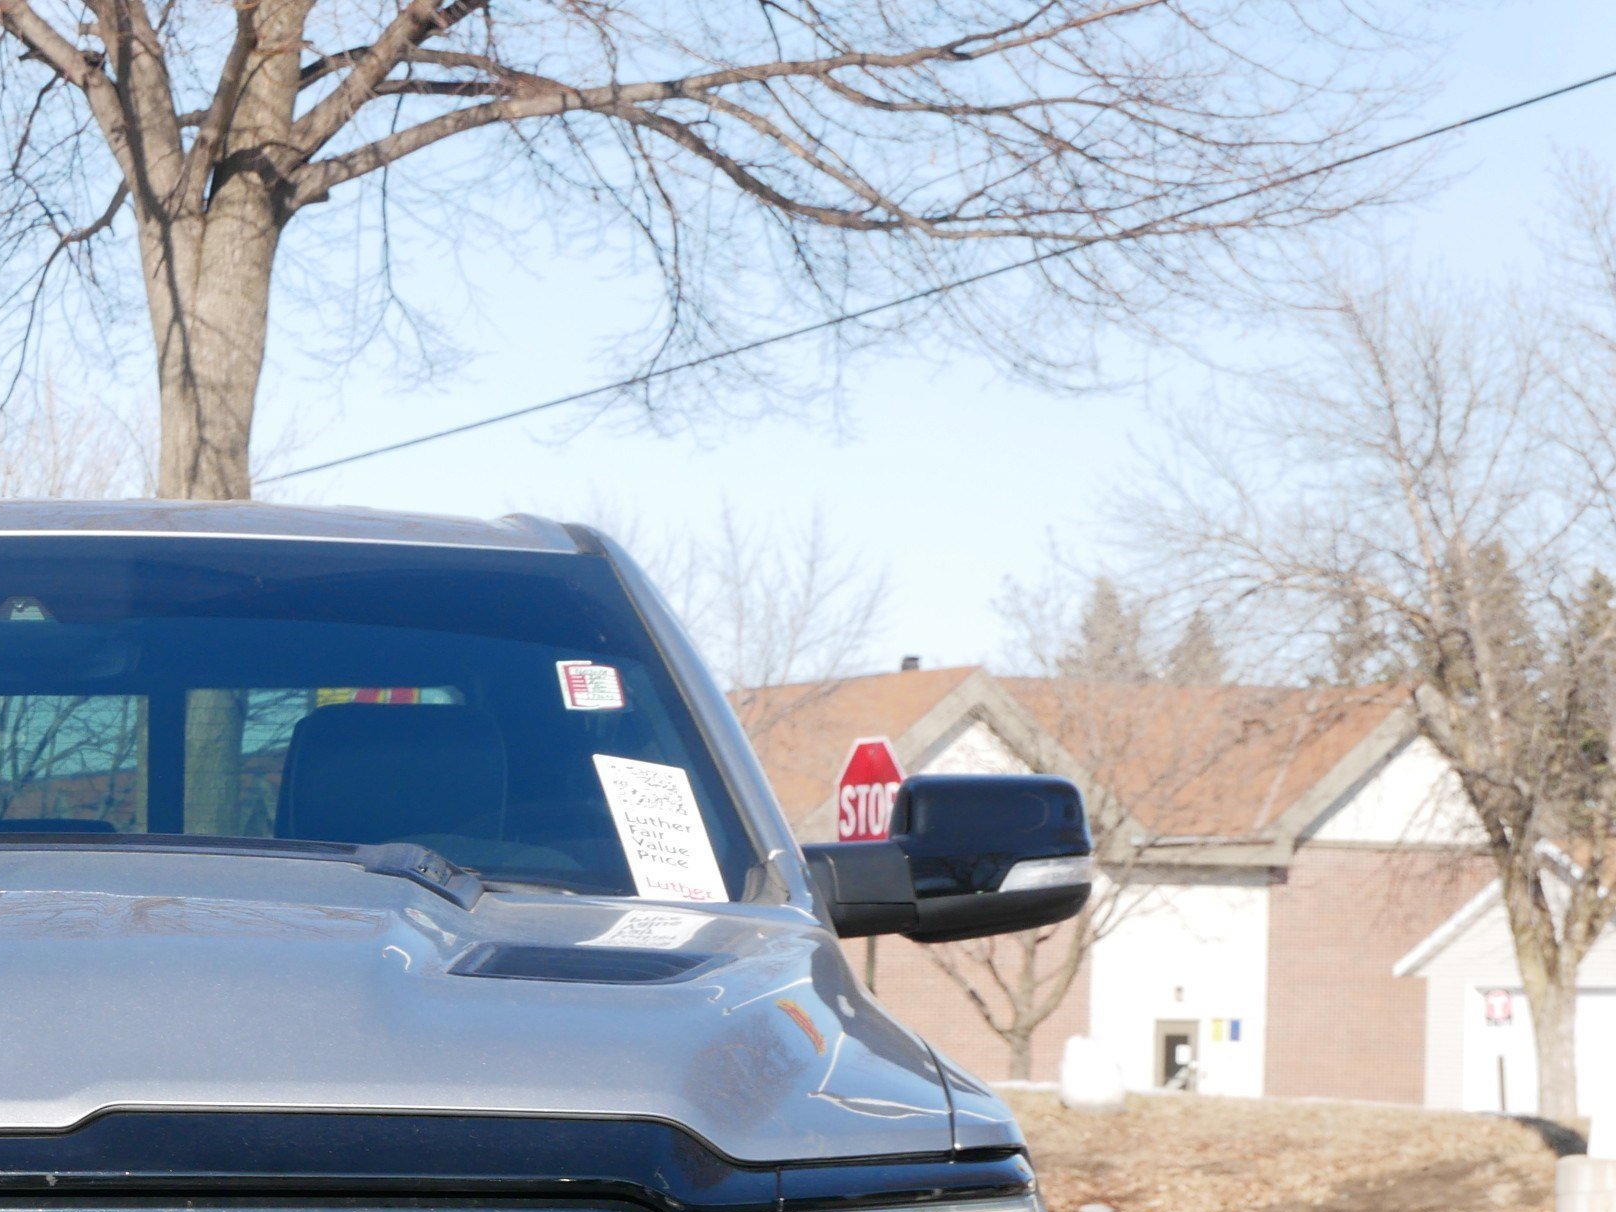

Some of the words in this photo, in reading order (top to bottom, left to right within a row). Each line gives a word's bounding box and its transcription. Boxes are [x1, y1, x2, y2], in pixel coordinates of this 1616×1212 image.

[624, 812, 691, 833] Luther
[629, 824, 664, 840] Fair
[632, 836, 690, 857] Value
[637, 849, 689, 868] Price
[646, 876, 715, 899] Luther
